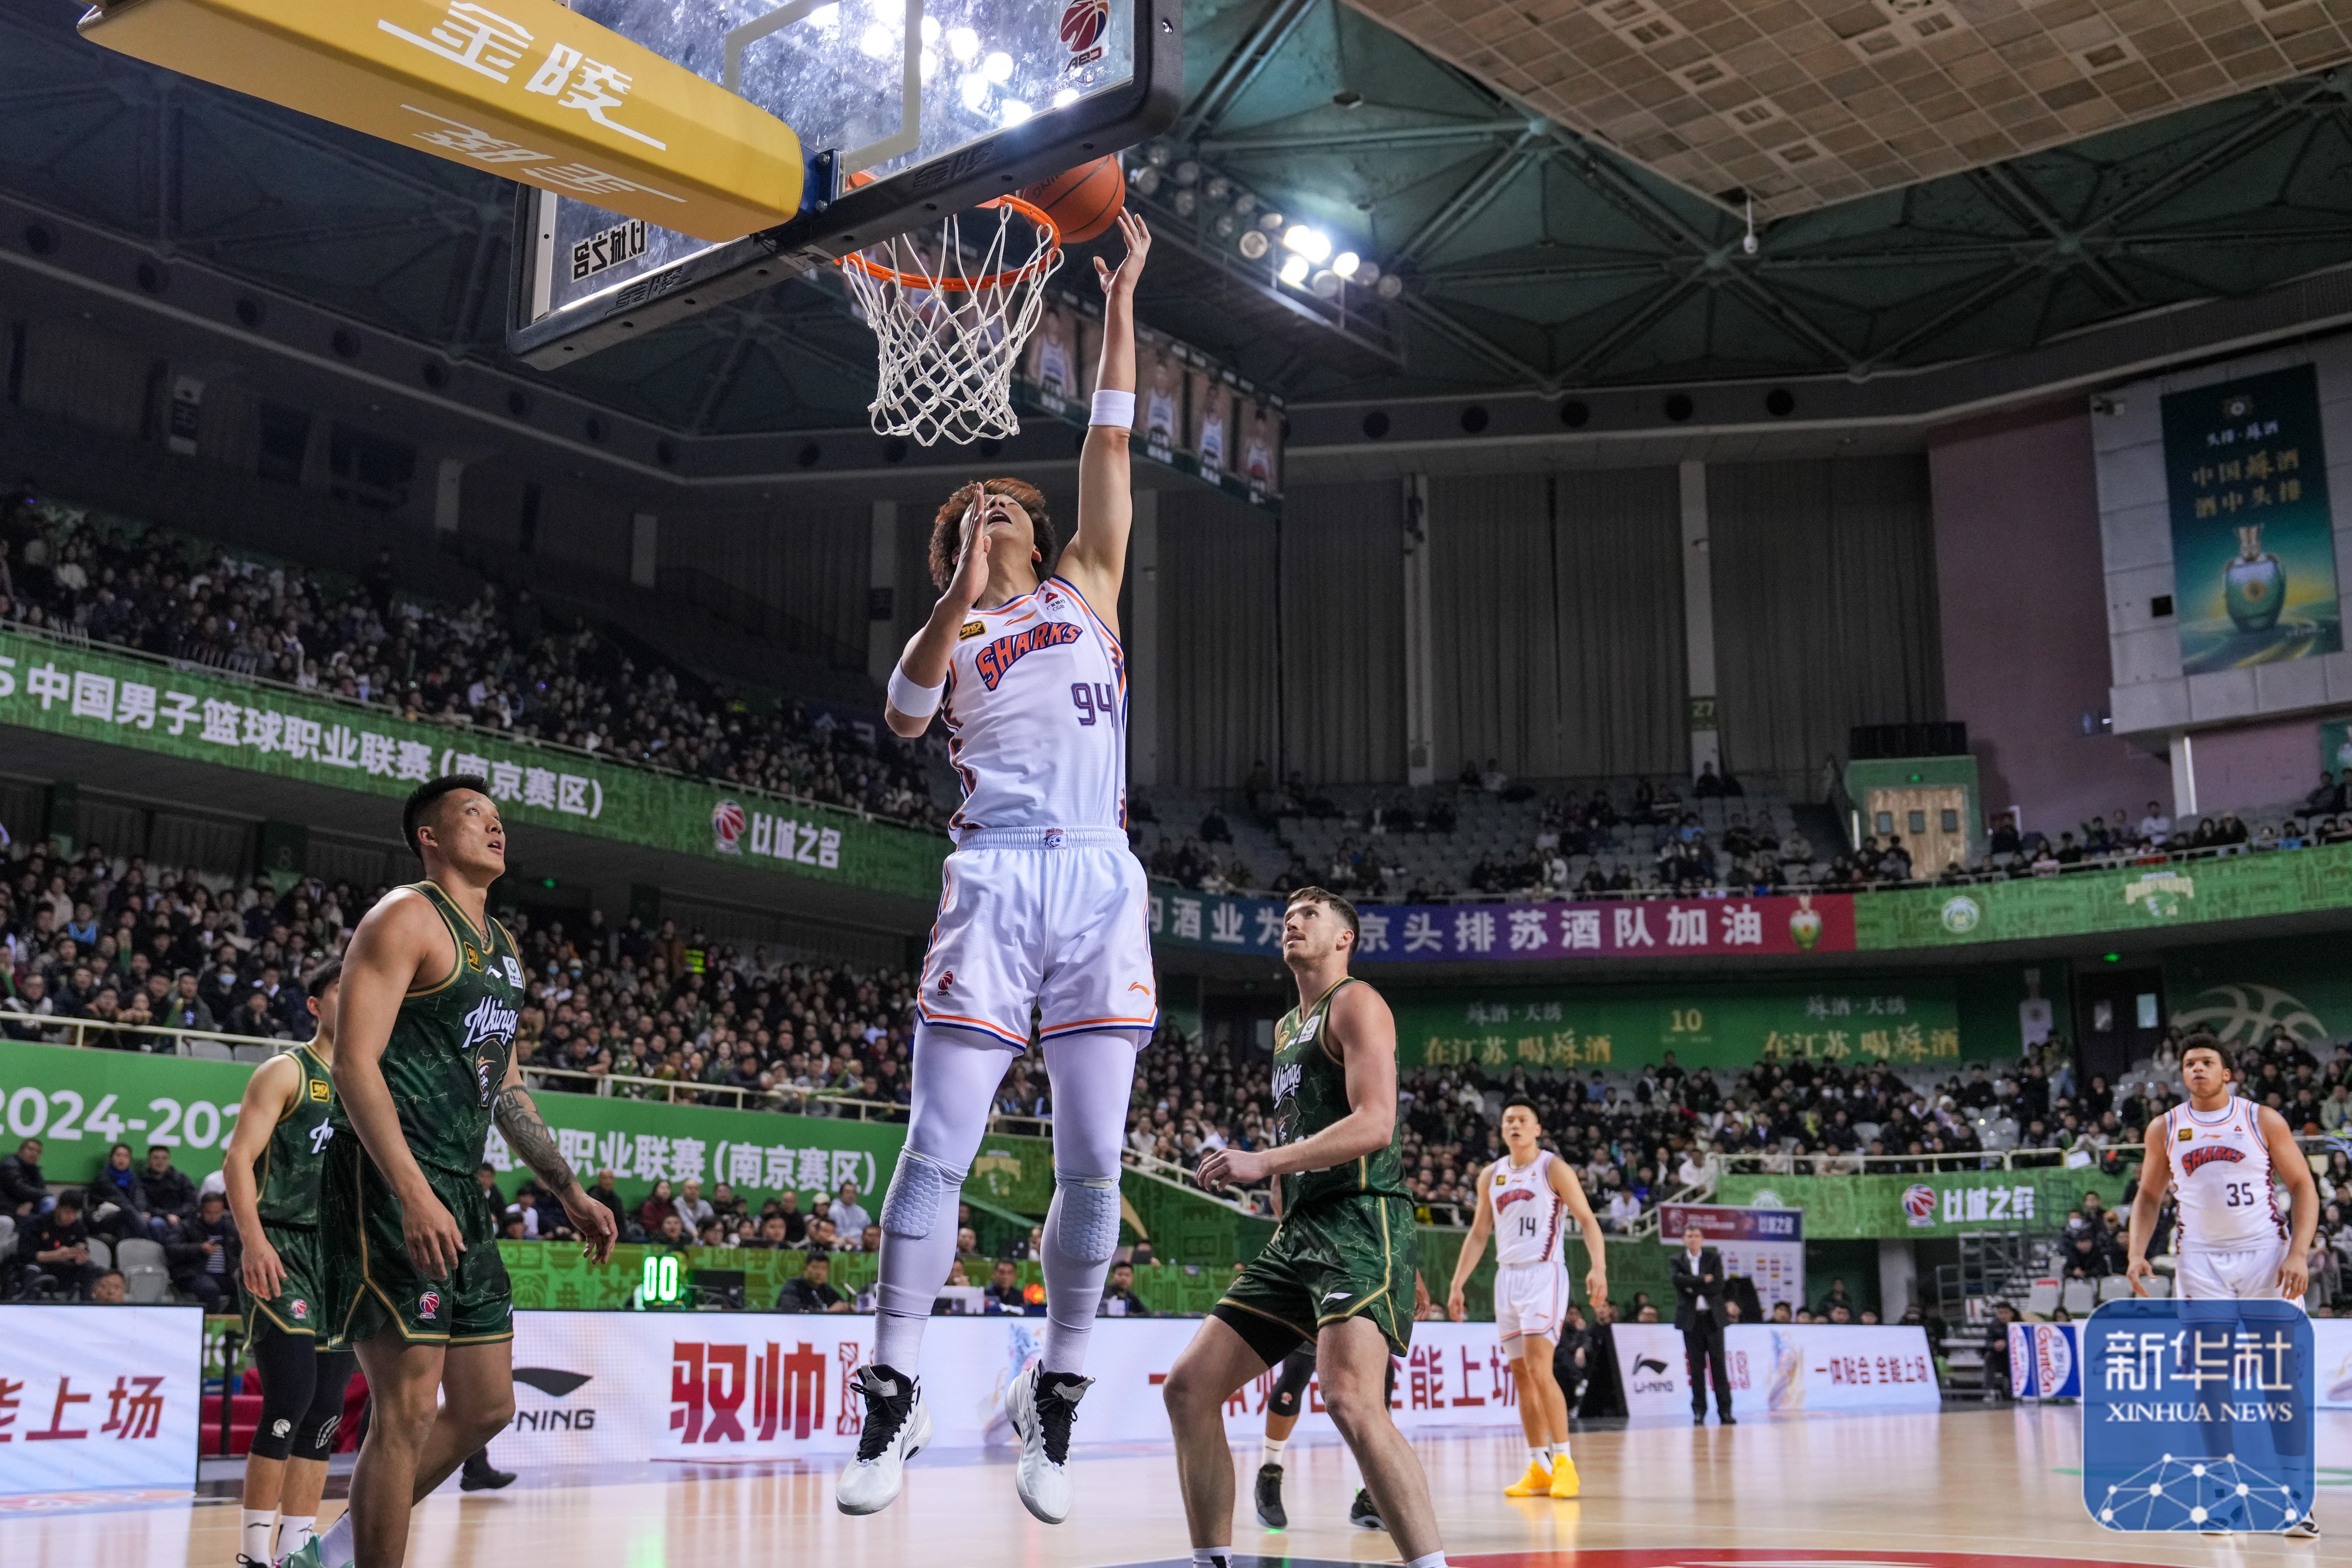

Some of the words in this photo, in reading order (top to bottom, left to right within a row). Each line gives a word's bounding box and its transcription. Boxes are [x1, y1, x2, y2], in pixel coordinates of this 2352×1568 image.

[377, 1, 666, 151] 金陵
[976, 621, 1083, 692] SHARKS
[1071, 682, 1114, 727] 94
[750, 811, 841, 870] 以城之名
[1148, 896, 1763, 952] 酒业为京头排苏酒队加油
[1671, 1008, 1702, 1032] 10
[2181, 1145, 2246, 1176] SHARKS
[1943, 1185, 2035, 1223] 以城之名
[2226, 1182, 2255, 1206] 35
[1519, 1217, 1536, 1236] 14
[643, 1256, 678, 1301] 00
[1815, 1358, 1871, 1385] 一体贴合
[1876, 1354, 1928, 1383] 全能上场
